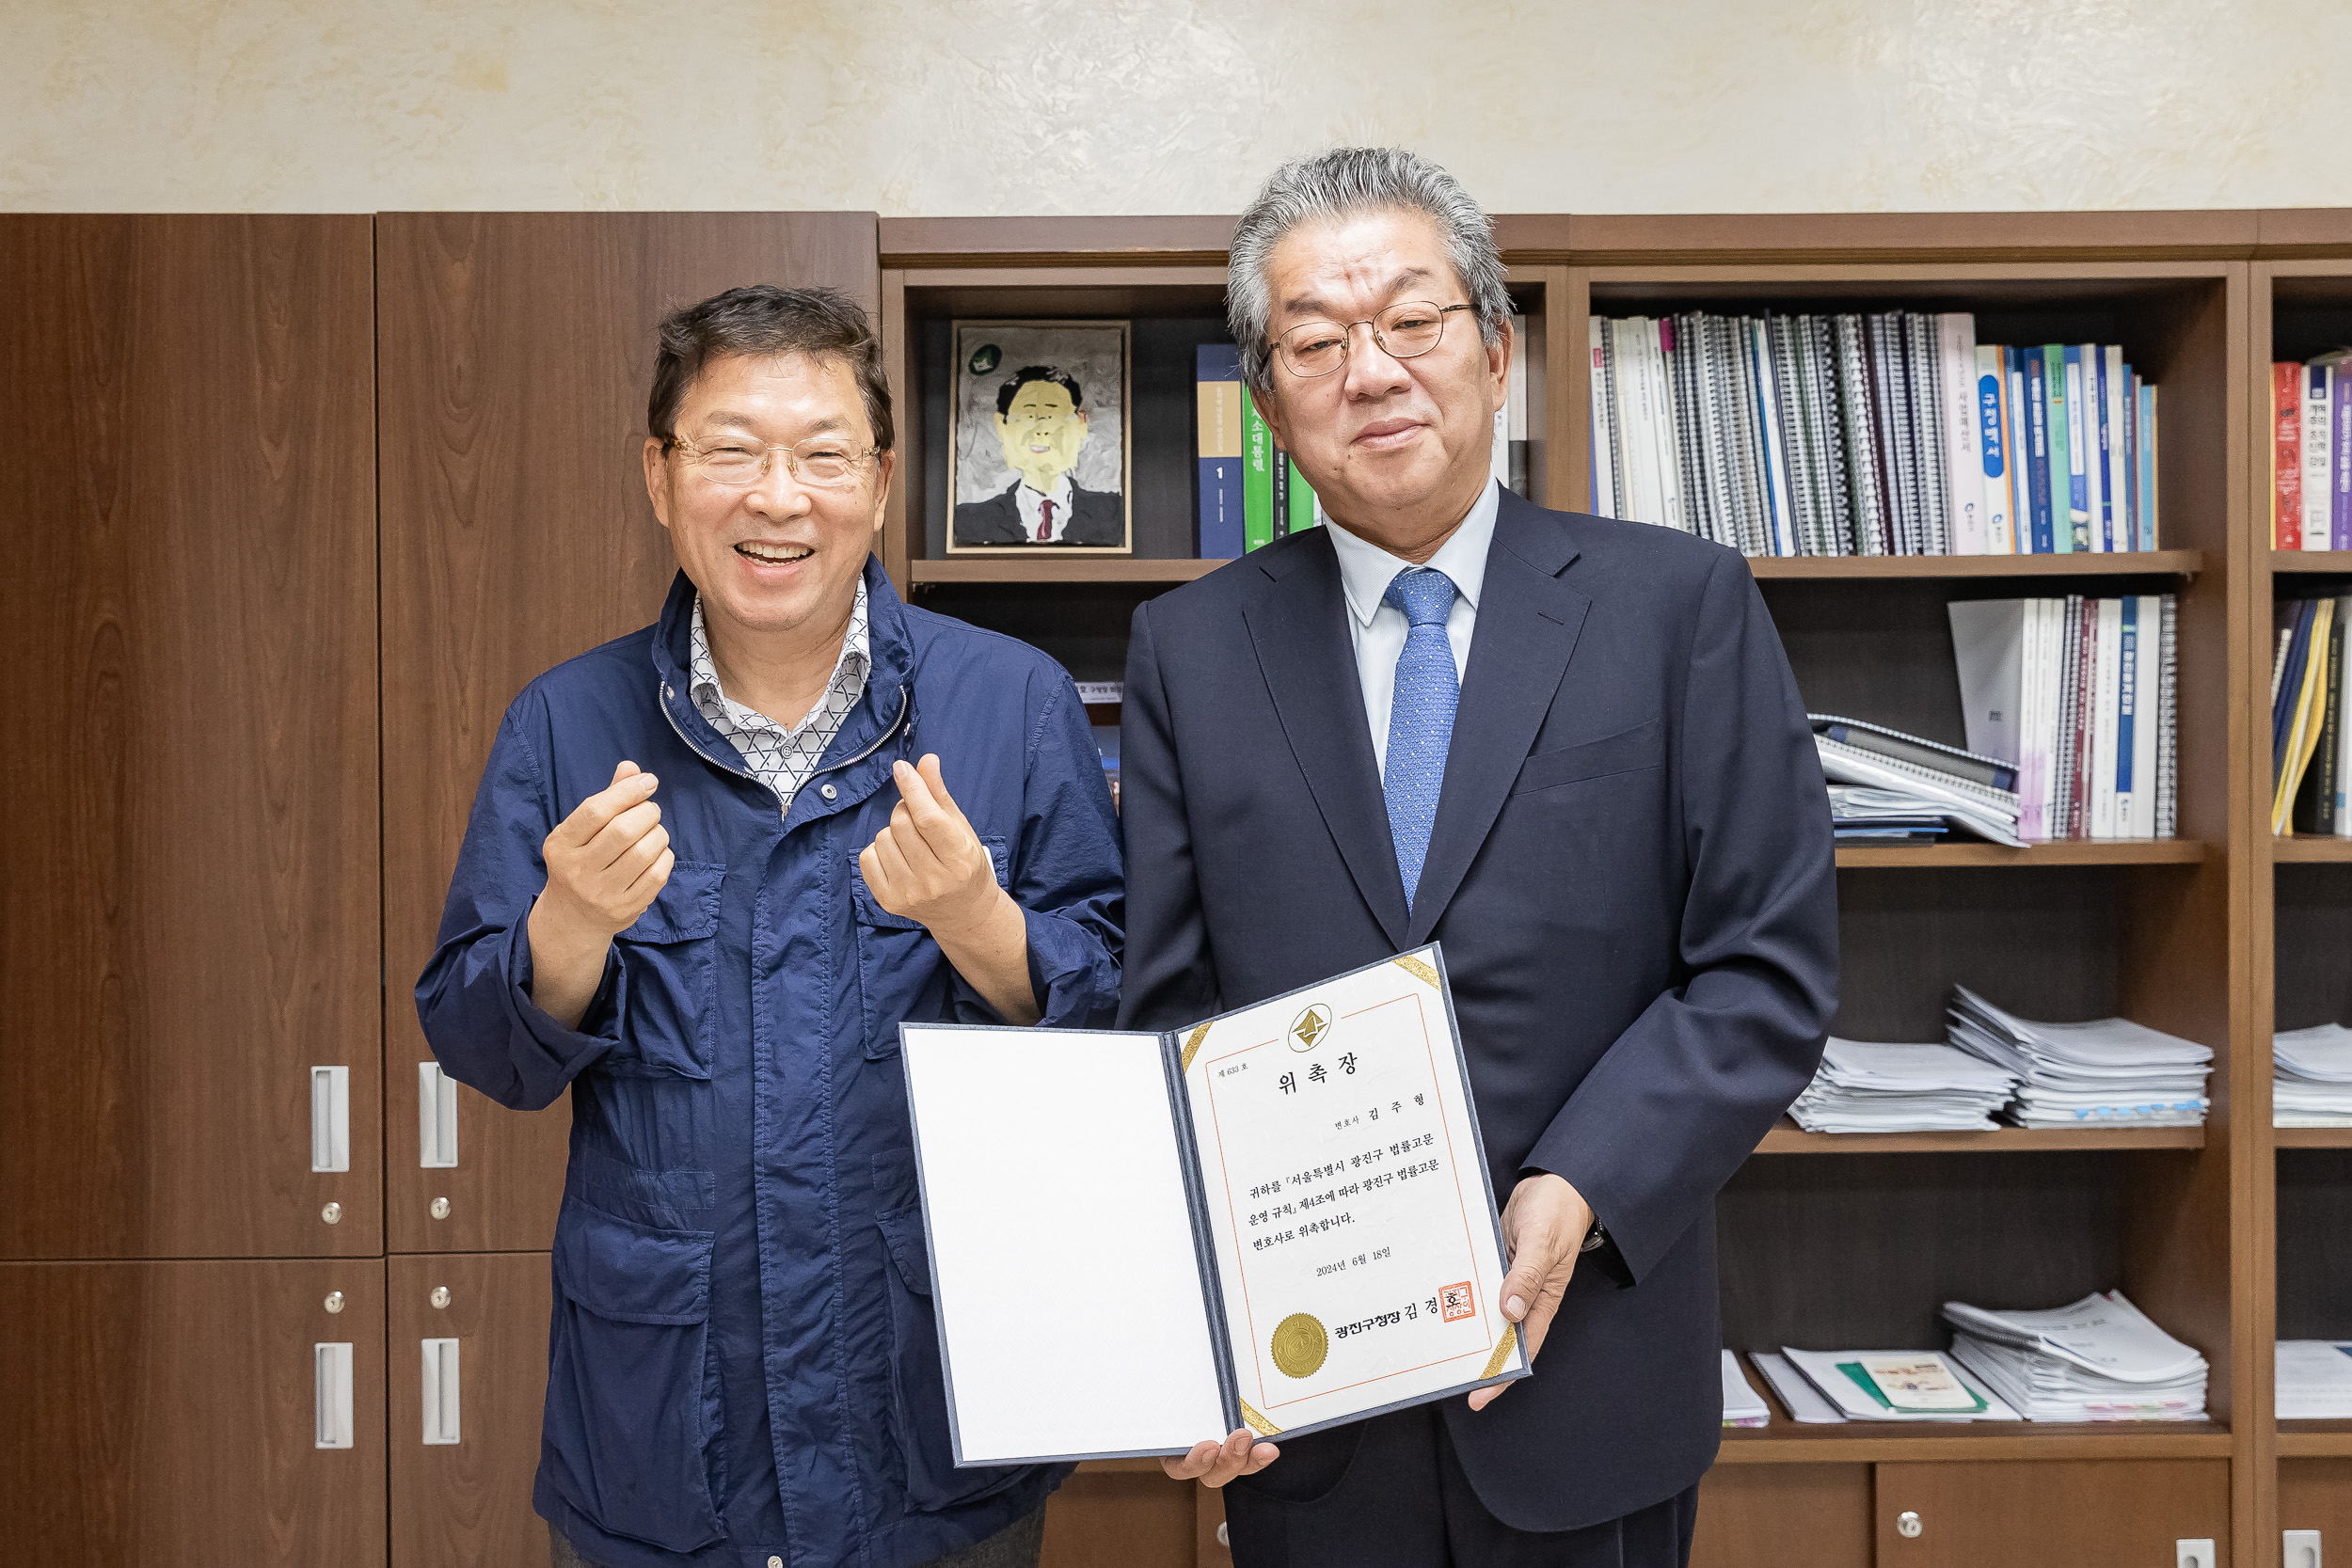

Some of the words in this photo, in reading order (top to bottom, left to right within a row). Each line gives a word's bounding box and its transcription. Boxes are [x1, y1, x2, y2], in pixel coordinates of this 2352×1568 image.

[1216, 467, 1223, 480] 1
[1335, 1116, 1359, 1130] 변호사
[1250, 1180, 1280, 1198] 귀하를
[1351, 1149, 1383, 1167] 광진구
[1390, 1133, 1433, 1156] 법률고문
[1249, 1211, 1267, 1226] 운영
[1299, 1190, 1335, 1210] 제4조에
[1339, 1183, 1359, 1197] 따라
[1363, 1173, 1393, 1191] 광진구
[1397, 1159, 1438, 1180] 법률고문
[1253, 1230, 1295, 1250] 변호사로
[1299, 1212, 1355, 1237] 위촉합니다.
[1317, 1260, 1345, 1276] 2024년
[1353, 1254, 1366, 1266] 6월
[1374, 1247, 1391, 1259] 18일
[1335, 1311, 1400, 1338] 광진구청장
